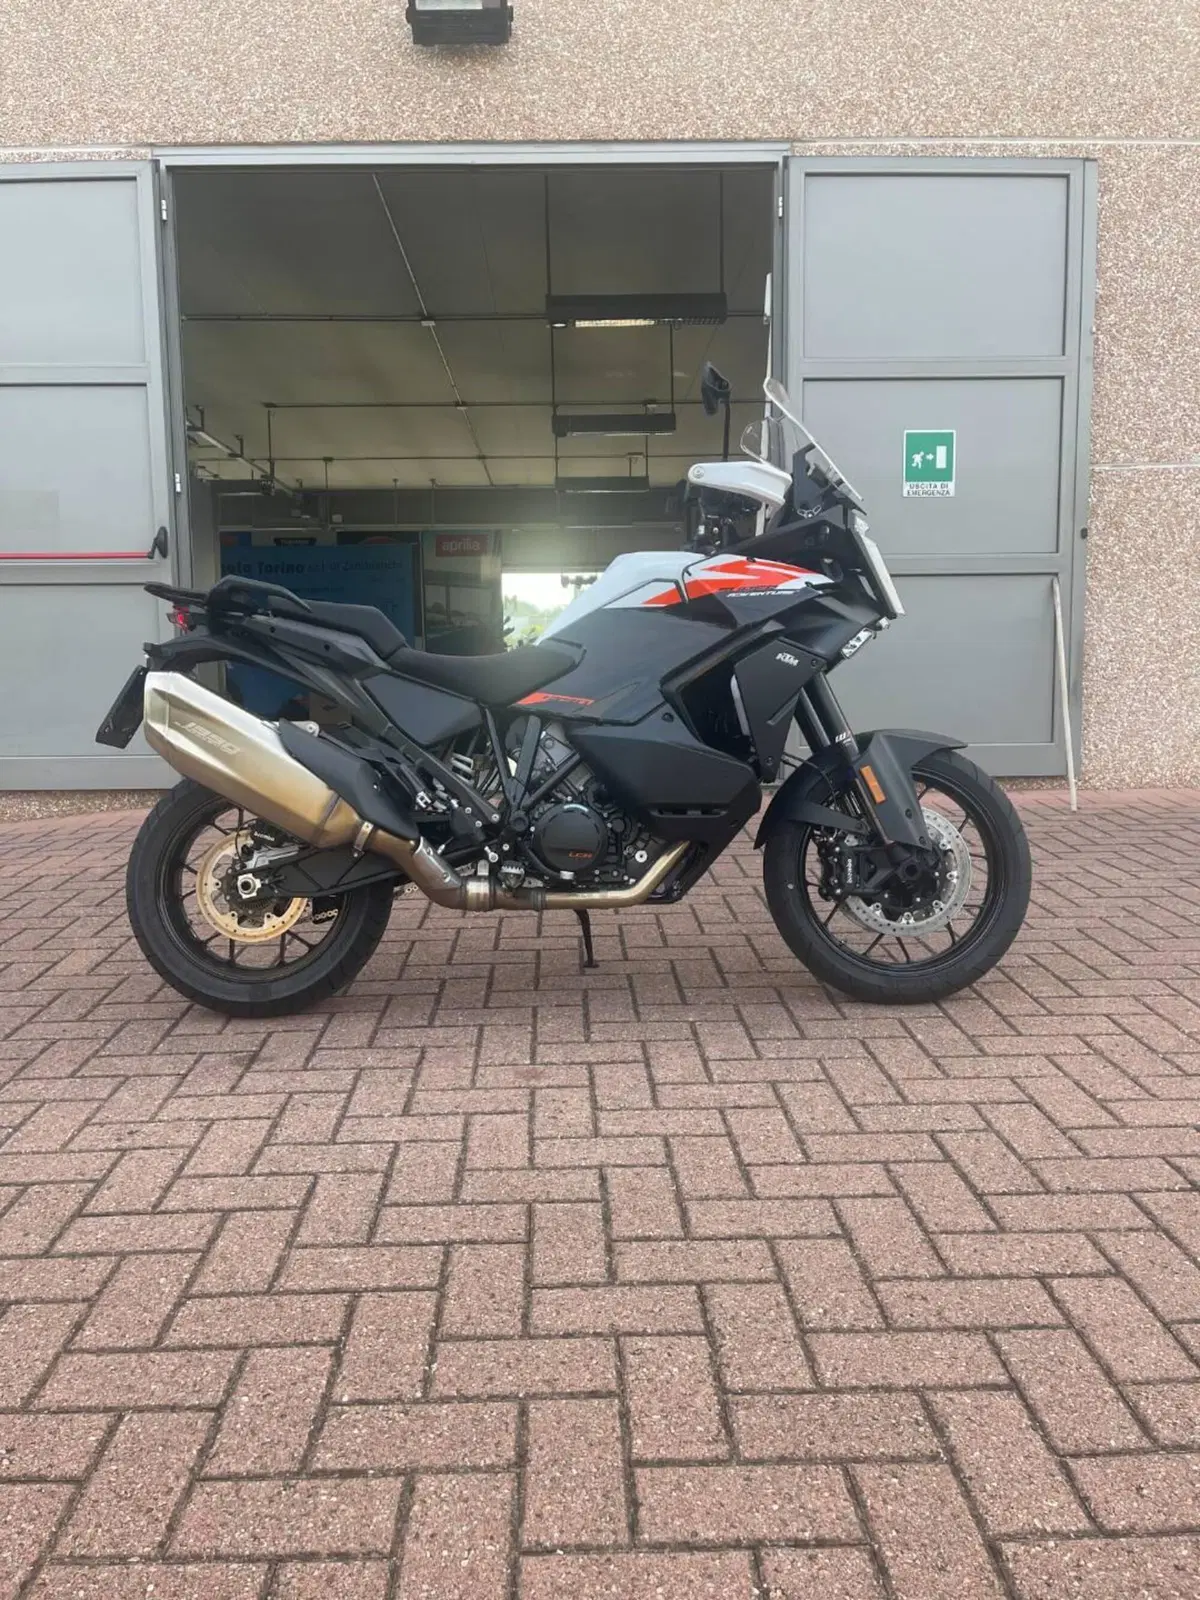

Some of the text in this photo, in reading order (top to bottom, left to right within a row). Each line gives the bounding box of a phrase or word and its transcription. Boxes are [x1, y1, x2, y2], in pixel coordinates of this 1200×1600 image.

[909, 482, 949, 490] USCITA DI
[442, 537, 481, 555] aprilia
[775, 652, 799, 667] KTM
